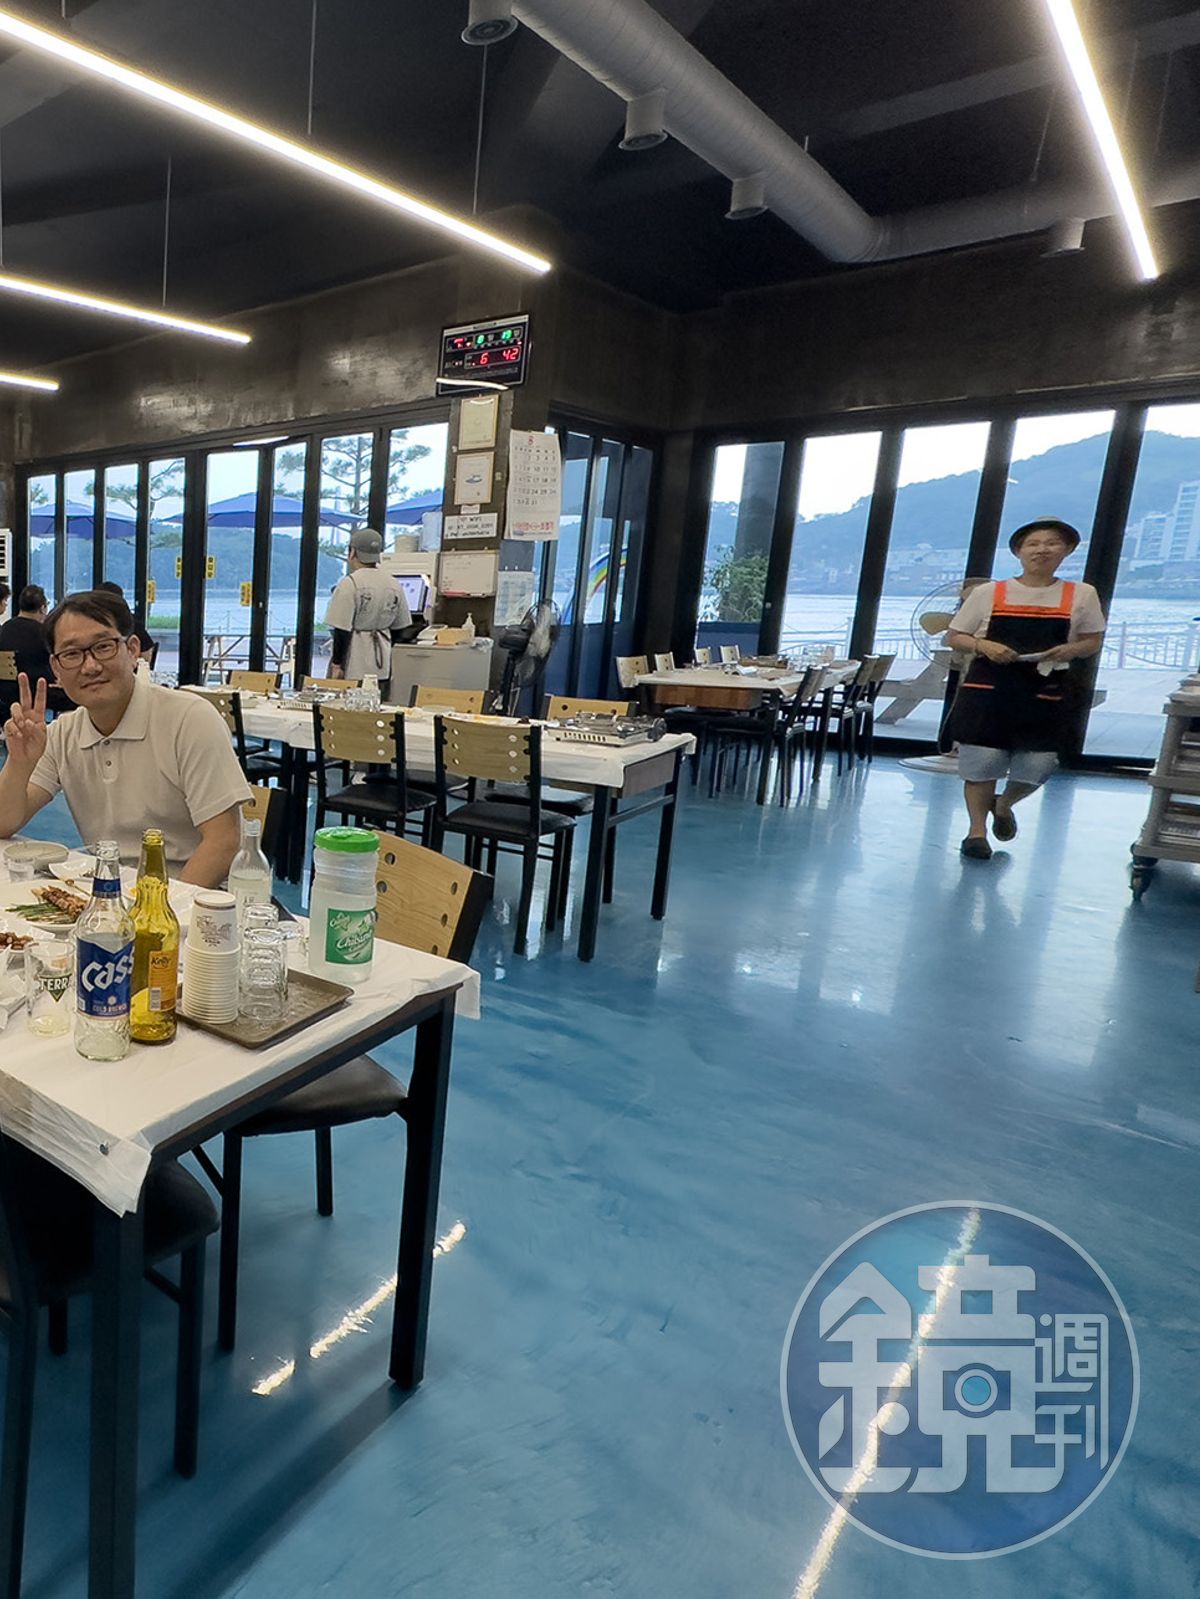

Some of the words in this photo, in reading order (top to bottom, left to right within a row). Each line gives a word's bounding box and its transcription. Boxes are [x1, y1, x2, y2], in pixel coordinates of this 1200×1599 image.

[480, 352, 489, 365] 6
[502, 348, 519, 360] 42
[39, 976, 72, 991] TERR
